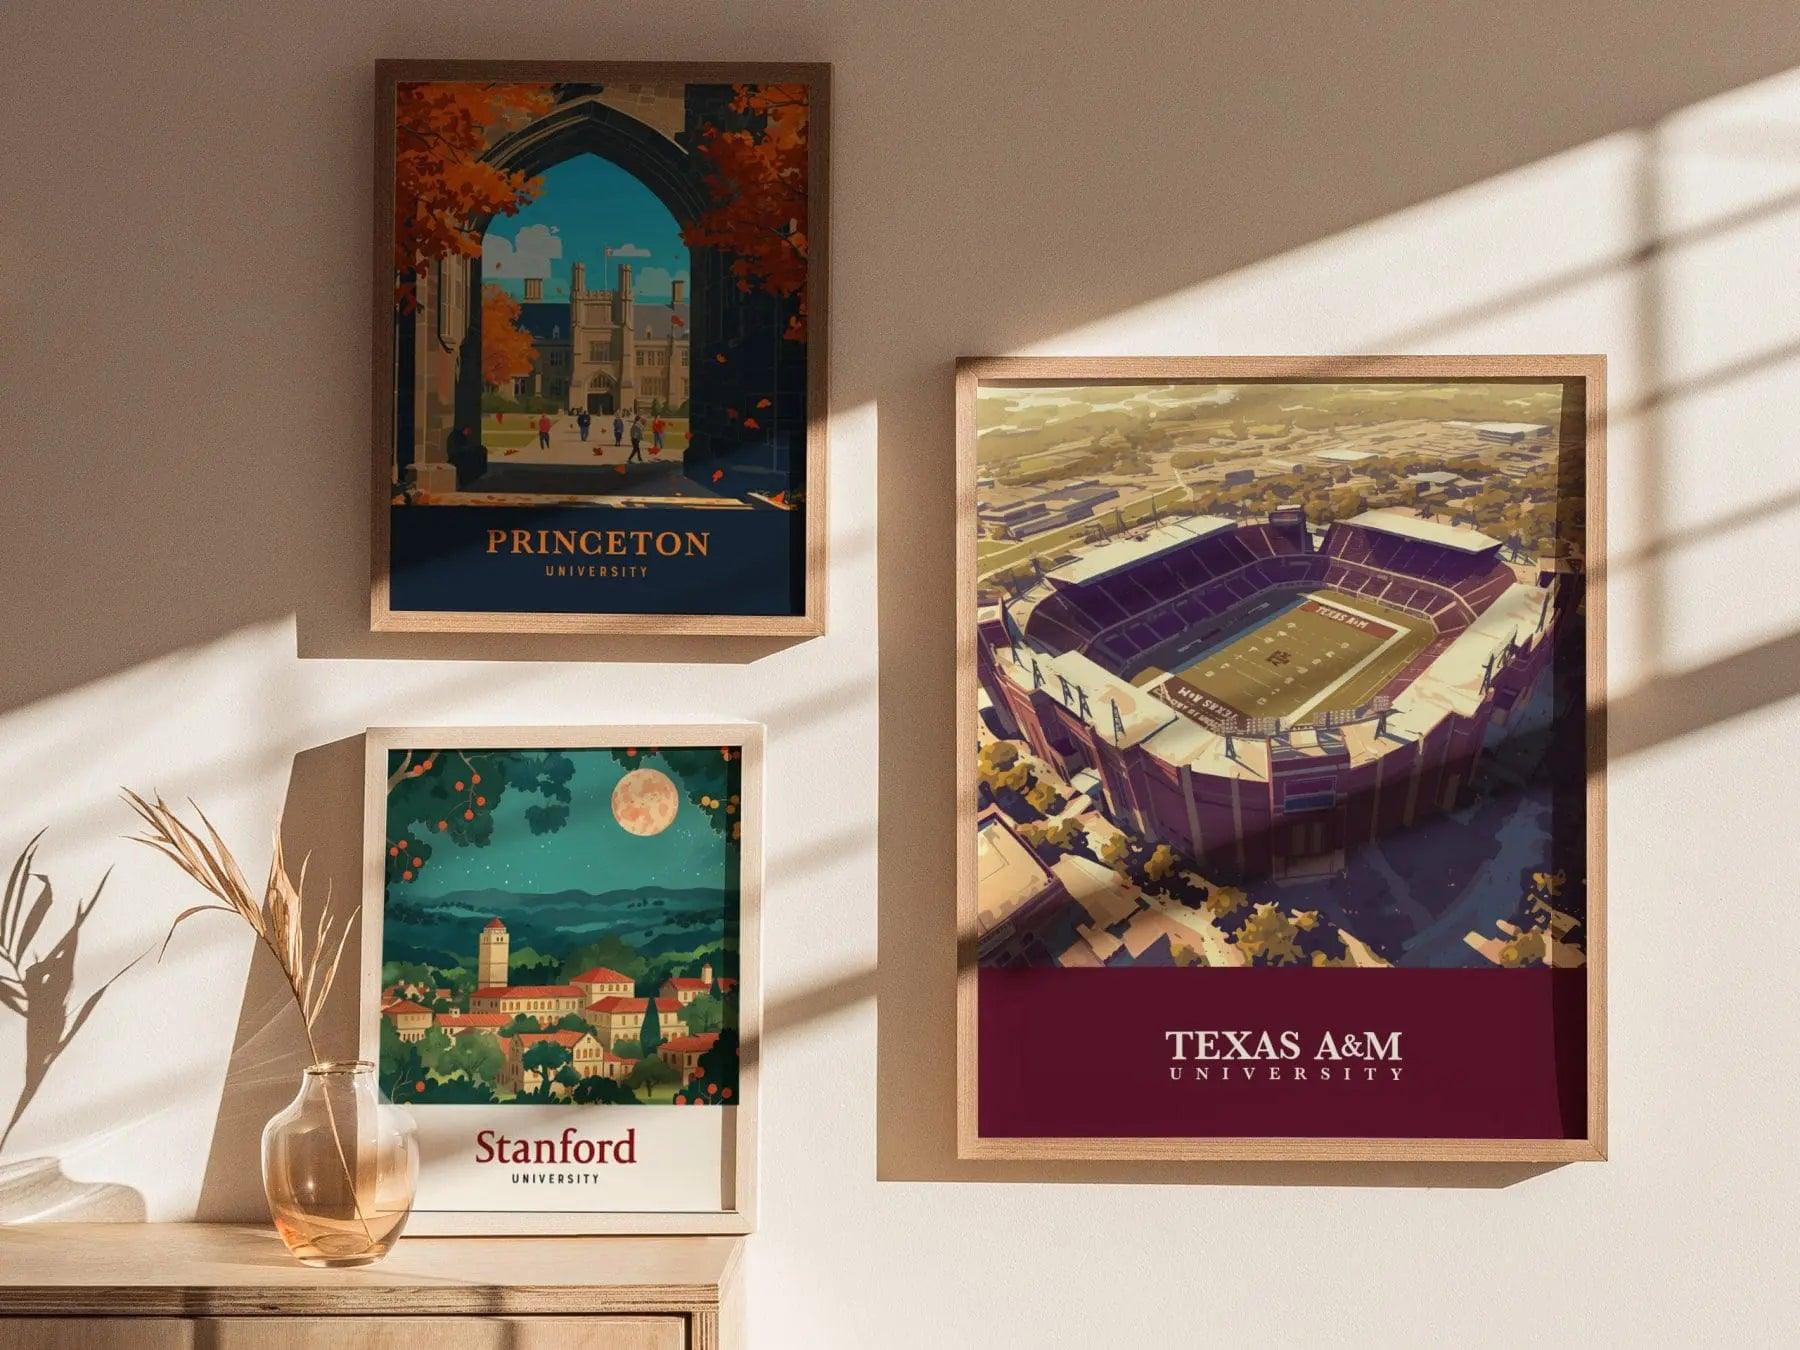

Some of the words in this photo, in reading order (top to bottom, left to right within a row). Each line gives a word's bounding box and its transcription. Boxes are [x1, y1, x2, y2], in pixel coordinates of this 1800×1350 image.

[486, 530, 710, 556] PRINCETON
[546, 565, 648, 577] UNIVERSITY
[1165, 1031, 1301, 1060] TEXAS
[1314, 1031, 1402, 1060] A&M
[1169, 1067, 1403, 1081] UNIVERSITY
[475, 1127, 637, 1163] Stanford
[512, 1173, 599, 1184] UNIVERSITY
